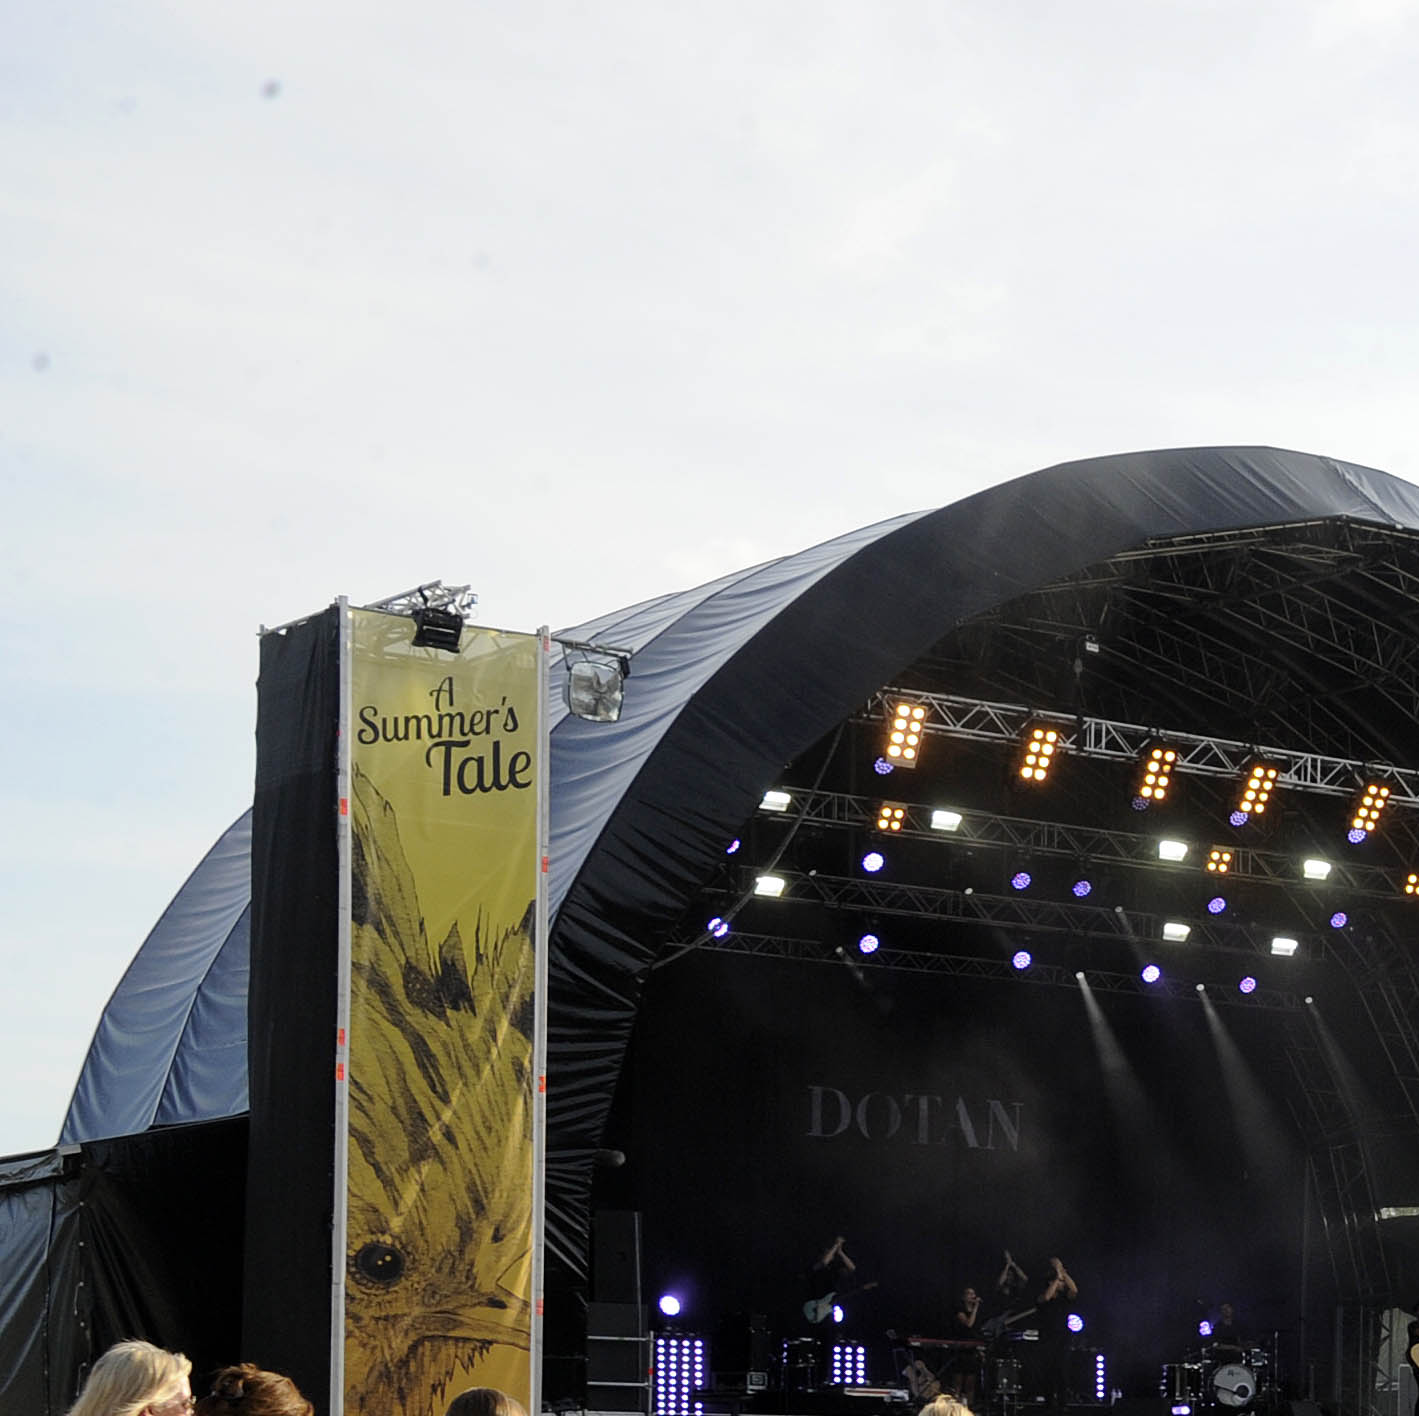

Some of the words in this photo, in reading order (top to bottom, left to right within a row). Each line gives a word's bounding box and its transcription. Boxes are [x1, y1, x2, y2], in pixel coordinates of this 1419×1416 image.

[357, 695, 519, 745] Summer's
[428, 676, 454, 712] A
[425, 739, 533, 797] Tale
[806, 1085, 1025, 1152] DOTAN
